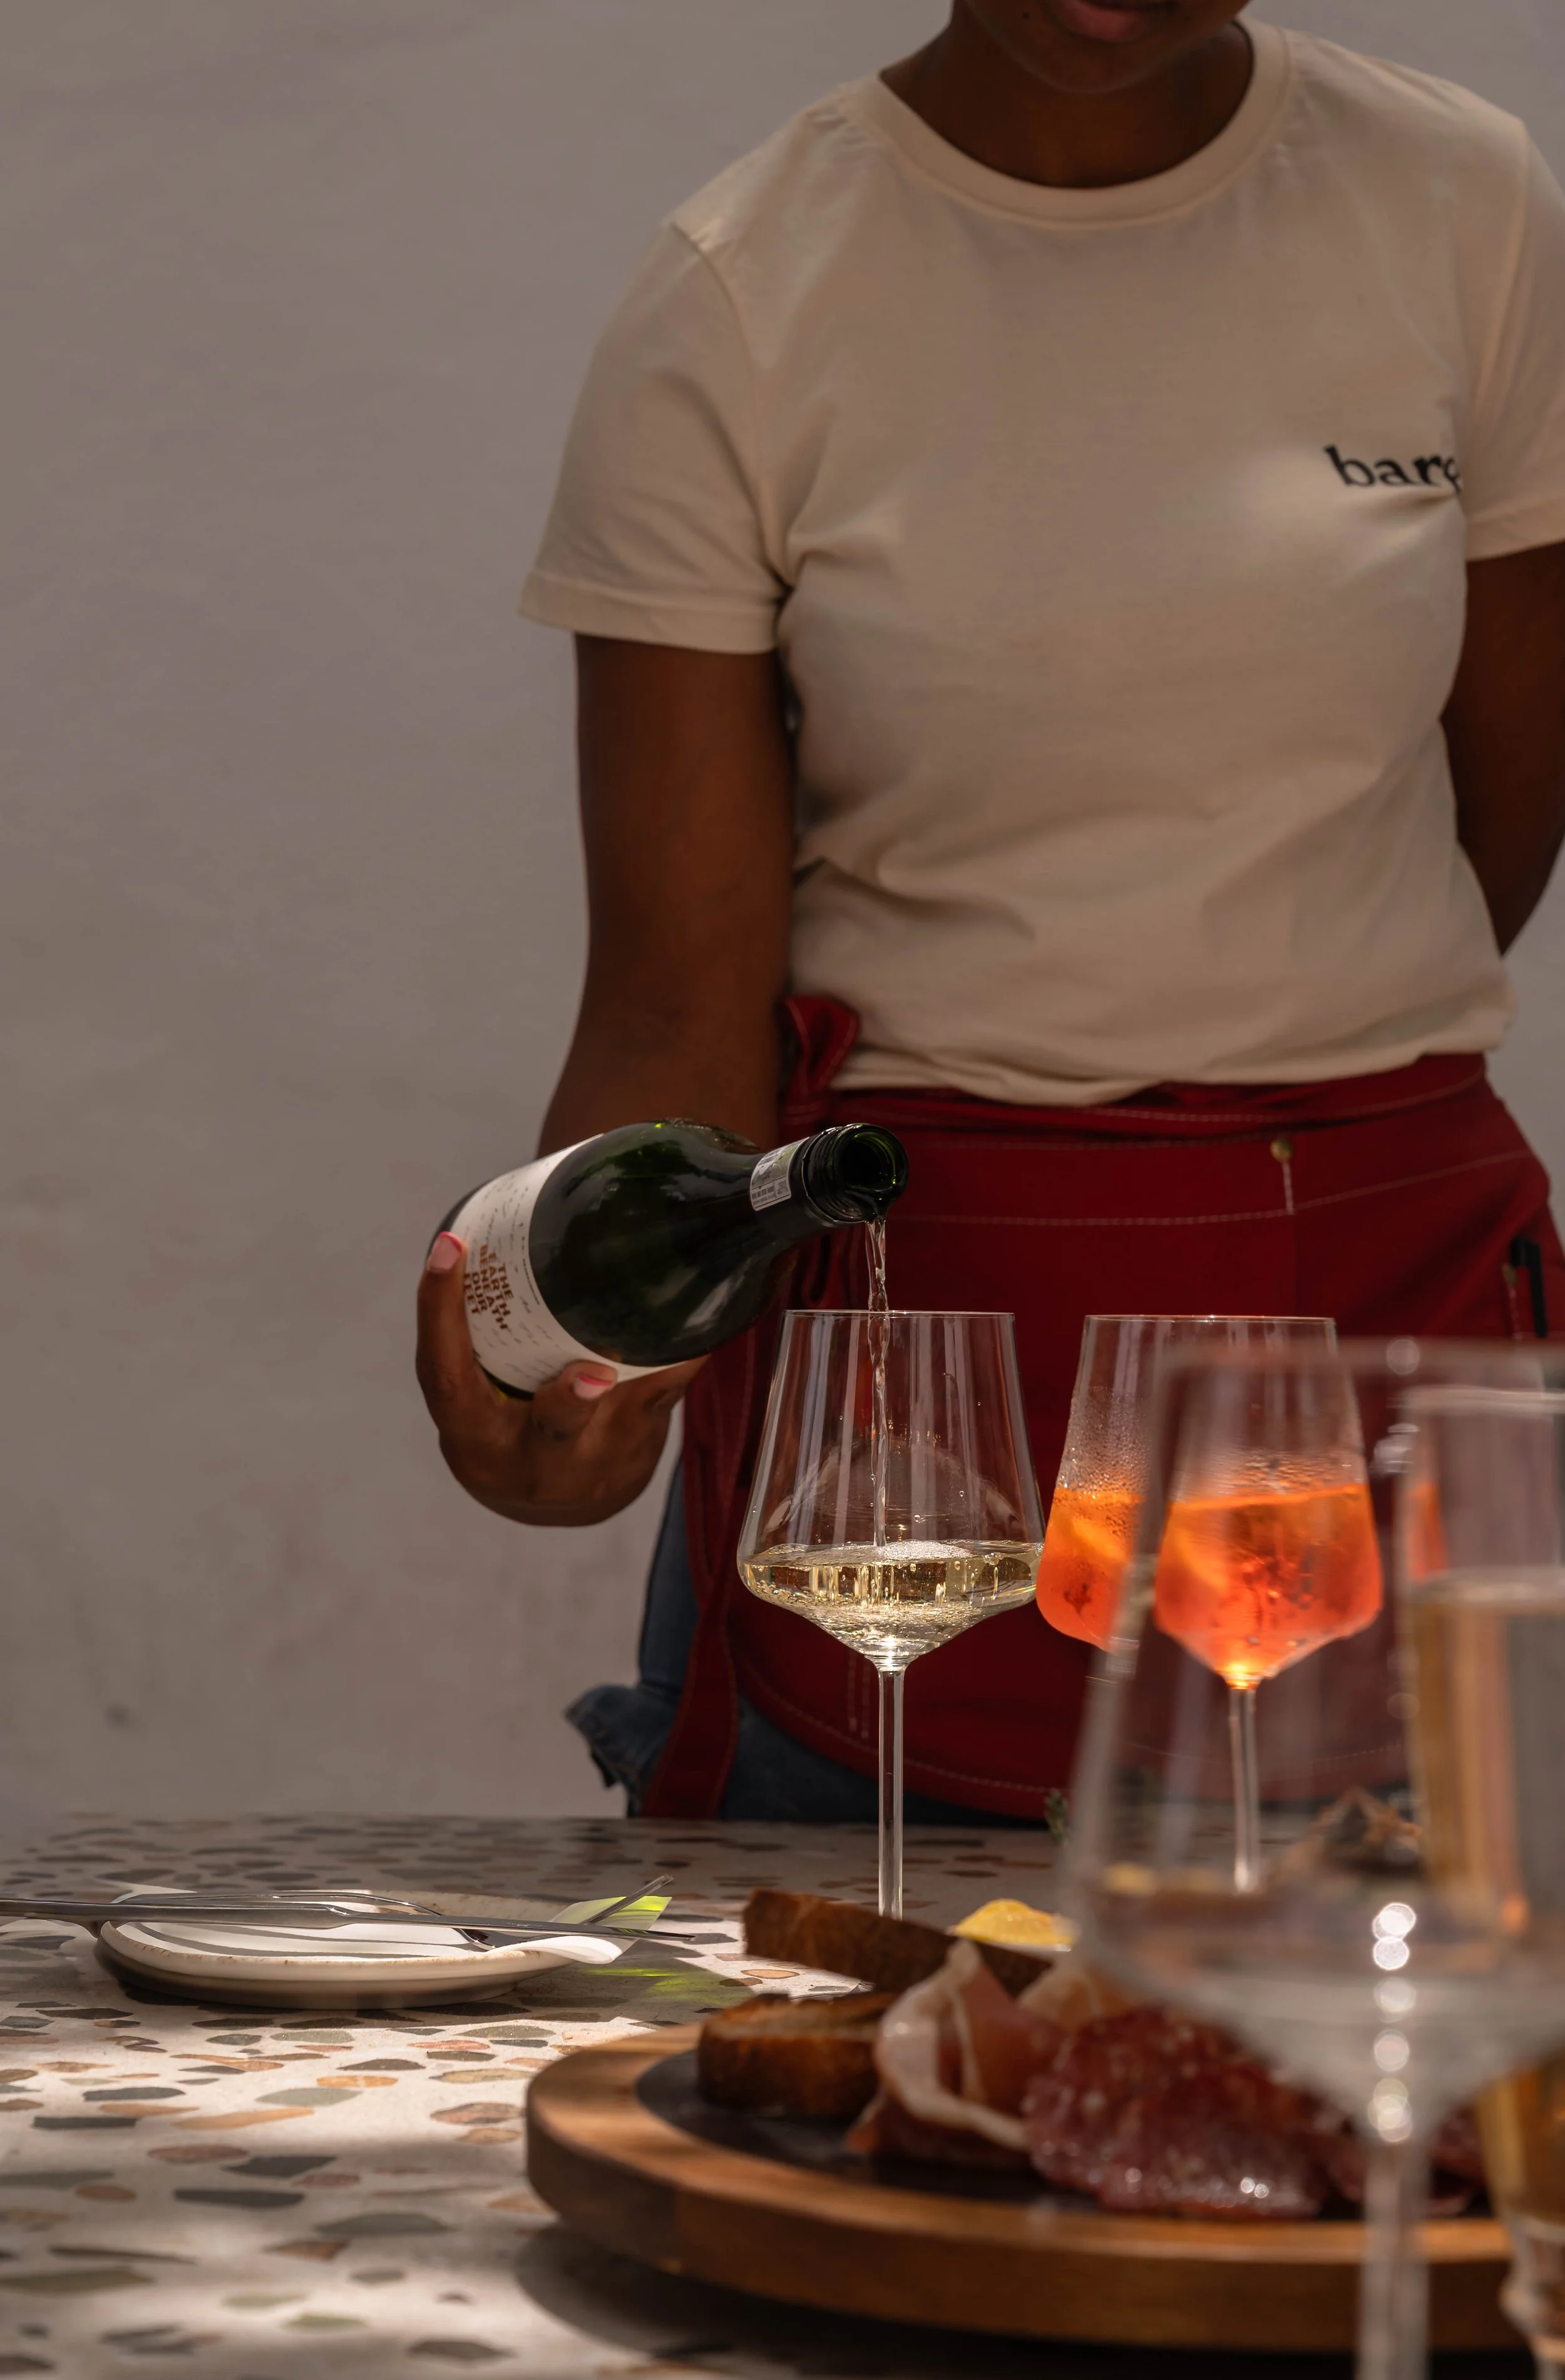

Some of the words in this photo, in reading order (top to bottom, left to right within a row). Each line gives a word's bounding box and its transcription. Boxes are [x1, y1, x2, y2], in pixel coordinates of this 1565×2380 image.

[464, 1272, 481, 1315] FEET
[471, 1272, 488, 1312] OUR
[480, 1244, 508, 1329] BENEATH
[488, 1252, 510, 1315] EARTH
[498, 1262, 515, 1300] THE
